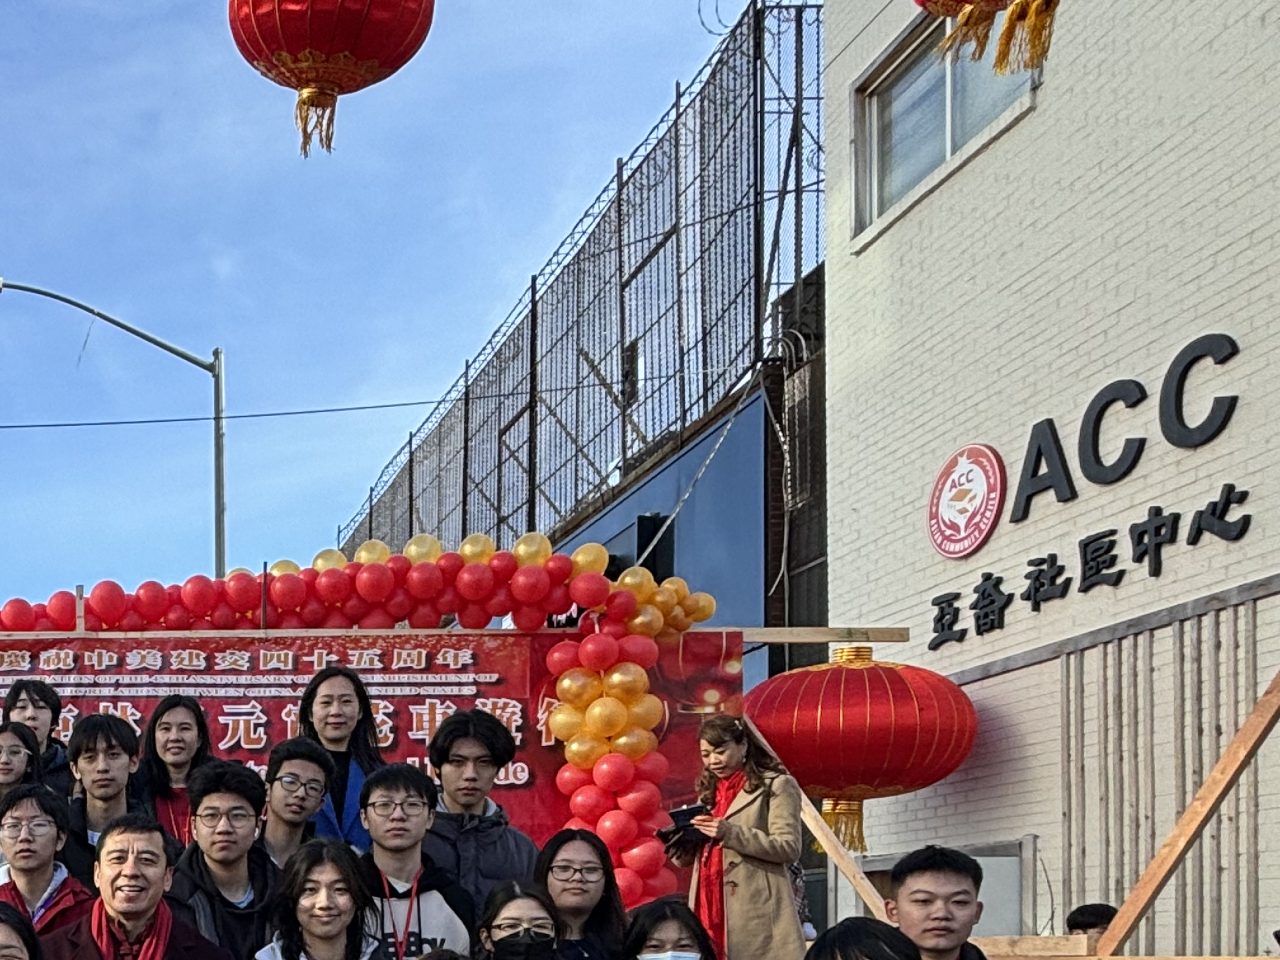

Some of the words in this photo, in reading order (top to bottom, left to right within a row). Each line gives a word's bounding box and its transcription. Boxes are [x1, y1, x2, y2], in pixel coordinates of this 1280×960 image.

[1010, 333, 1241, 523] ACC
[949, 469, 974, 493] ACC
[359, 674, 475, 682] STABLISHMENT
